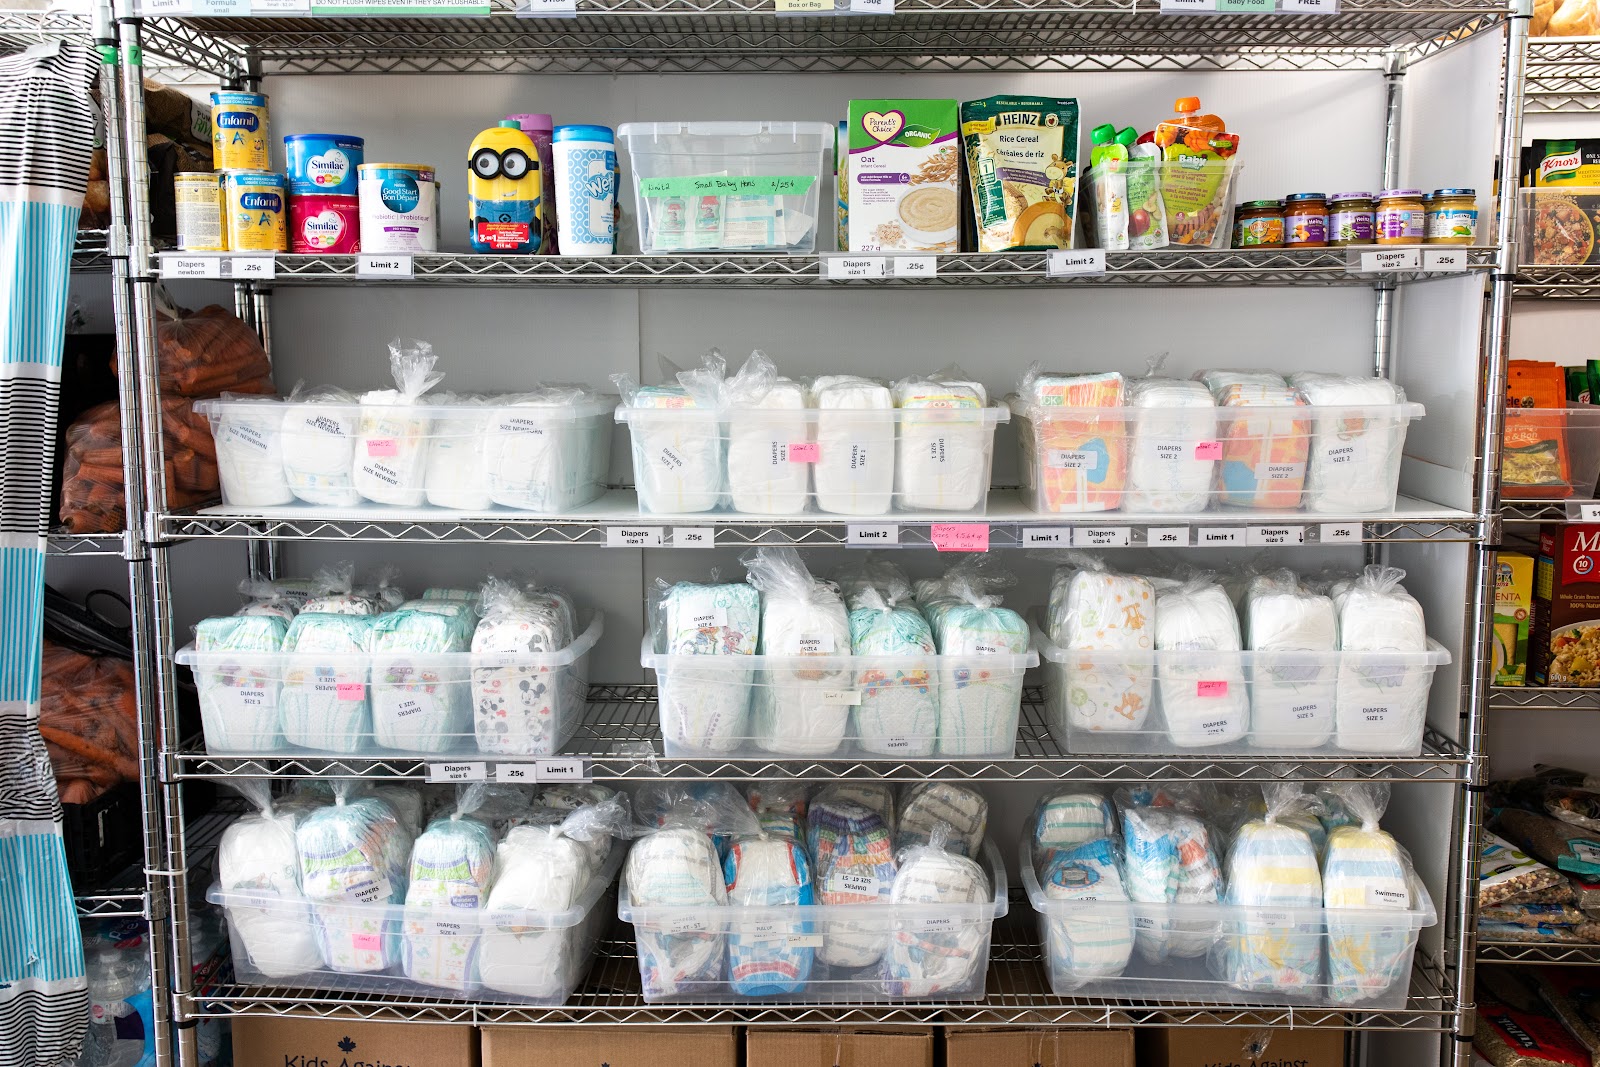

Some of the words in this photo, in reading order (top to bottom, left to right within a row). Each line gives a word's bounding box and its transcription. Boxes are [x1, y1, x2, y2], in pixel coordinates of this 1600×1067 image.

[219, 115, 255, 127] Enfamil
[869, 117, 897, 126] Parent's
[1003, 113, 1038, 126] HEINZ
[872, 125, 893, 133] Choice
[904, 131, 932, 140] ORGANIC
[999, 135, 1015, 143] Rice
[1016, 135, 1039, 143] Cereal
[1024, 150, 1034, 158] de
[1035, 150, 1045, 158] riz
[311, 159, 344, 170] Similac
[1178, 154, 1208, 167] Baby
[1541, 157, 1580, 172] Knorr
[716, 180, 737, 192] Baby
[383, 187, 402, 195] Good
[402, 188, 418, 196] Start
[244, 196, 280, 208] Enfamil
[396, 194, 419, 203] Départ
[306, 221, 339, 231] Similac
[1065, 258, 1087, 266] Limit
[1376, 253, 1405, 262] Diapers
[177, 260, 206, 269] Diapers
[244, 264, 262, 272] .25¢
[370, 261, 392, 269] Limit
[843, 260, 871, 269] Diapers
[229, 427, 239, 436] SIZE
[240, 433, 268, 450] NEWBORN
[1328, 447, 1354, 456] DIAPERS
[662, 447, 683, 467] DIAPERS
[362, 466, 375, 475] SIZE
[374, 463, 397, 477] DIAPERS
[621, 530, 649, 539] Diapers
[1087, 530, 1116, 539] Diapers
[1260, 528, 1289, 537] Diapers
[1578, 560, 1588, 568] 10
[693, 614, 715, 622] DIAPERS
[397, 706, 422, 717] DIAPERS
[1292, 704, 1318, 713] DIAPERS
[1202, 720, 1228, 729] DIAPERS
[444, 765, 472, 773] Diapers
[844, 883, 867, 891] DIAPERS
[354, 885, 380, 899] DIAPERS
[1375, 889, 1405, 899] Swimmers
[361, 896, 373, 904] SIZE
[436, 922, 461, 930] DIAPERS
